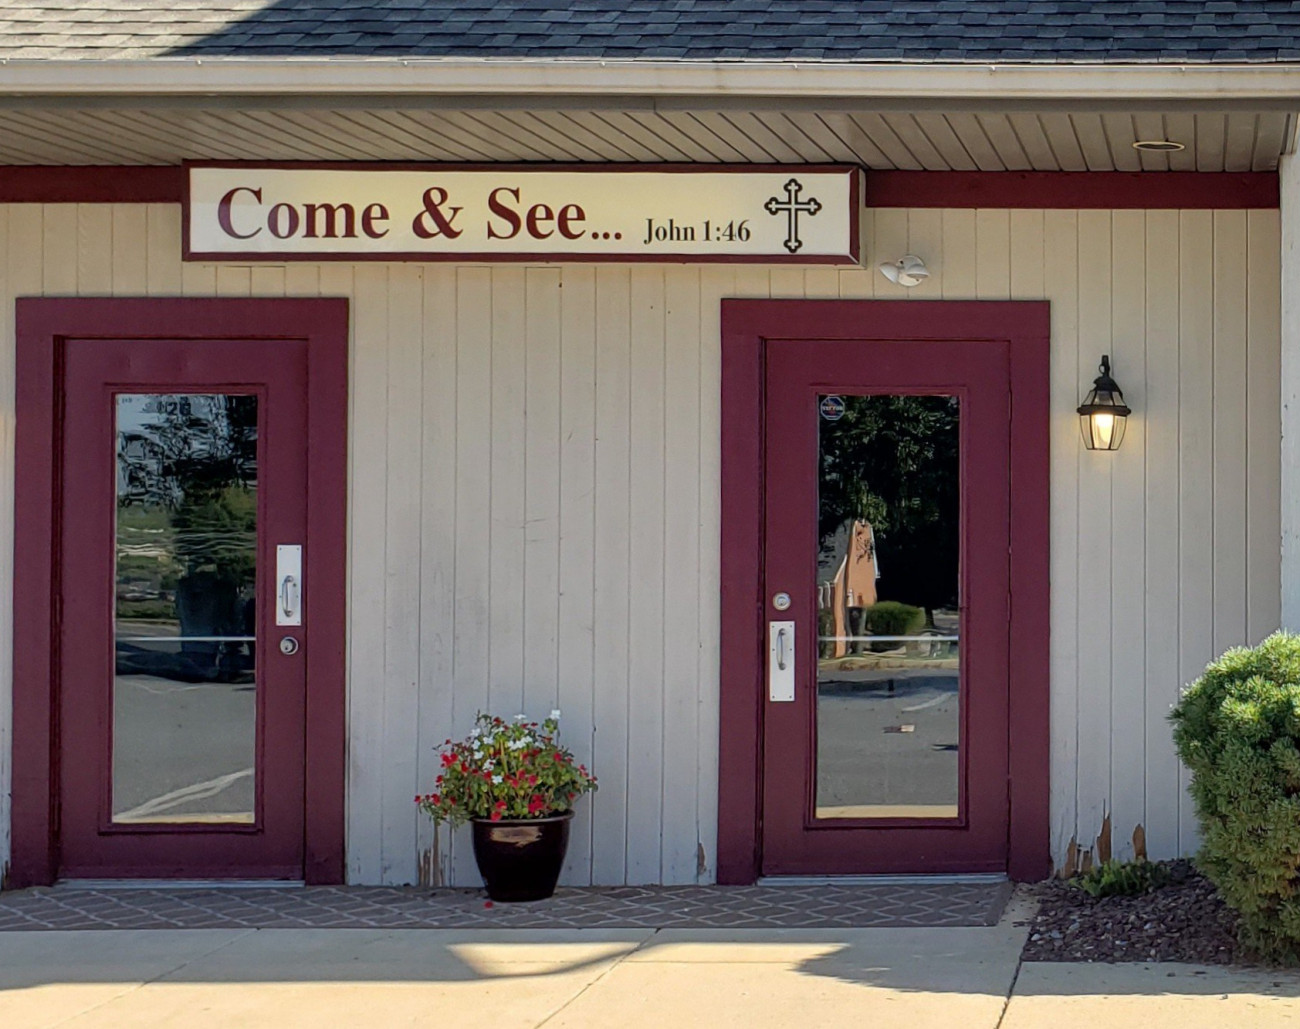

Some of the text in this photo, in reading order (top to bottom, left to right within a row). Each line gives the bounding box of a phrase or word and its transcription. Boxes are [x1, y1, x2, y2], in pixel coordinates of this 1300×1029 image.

[217, 186, 623, 240] Come & See...
[643, 218, 752, 245] John 1:46
